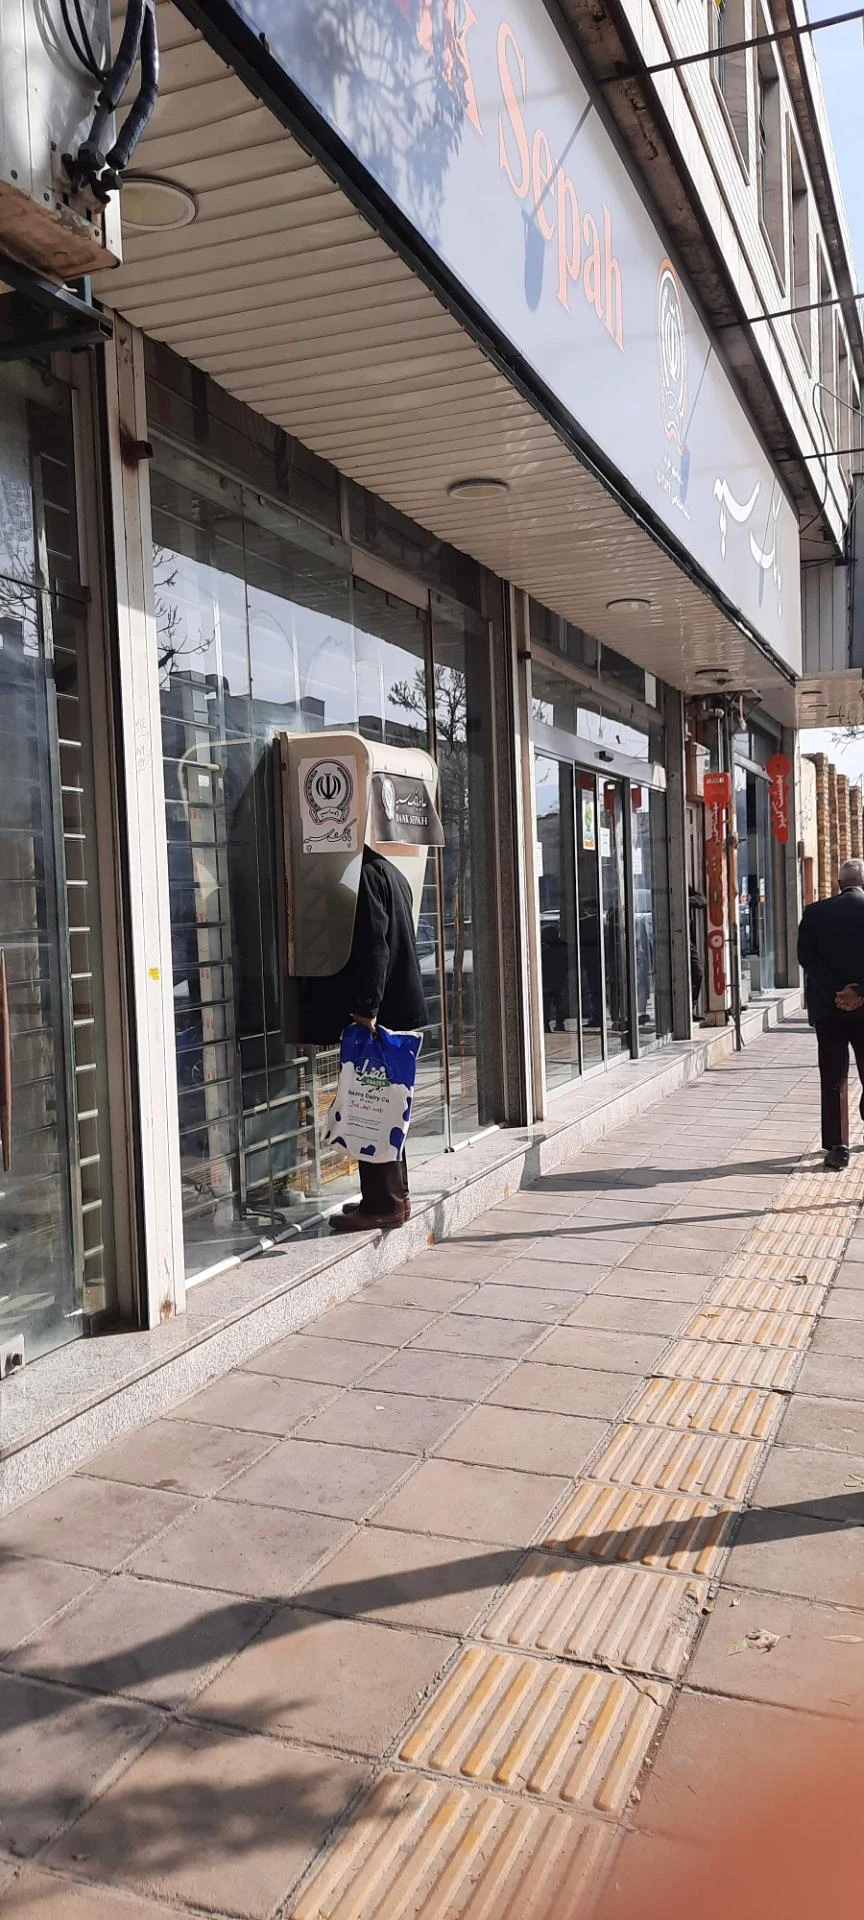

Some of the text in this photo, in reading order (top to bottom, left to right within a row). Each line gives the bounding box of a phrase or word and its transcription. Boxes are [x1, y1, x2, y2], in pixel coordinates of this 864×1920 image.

[496, 22, 624, 352] Sepah
[713, 477, 761, 561] سپه
[303, 818, 356, 852] بانک سپه
[395, 812, 428, 826] BANK SEPAH
